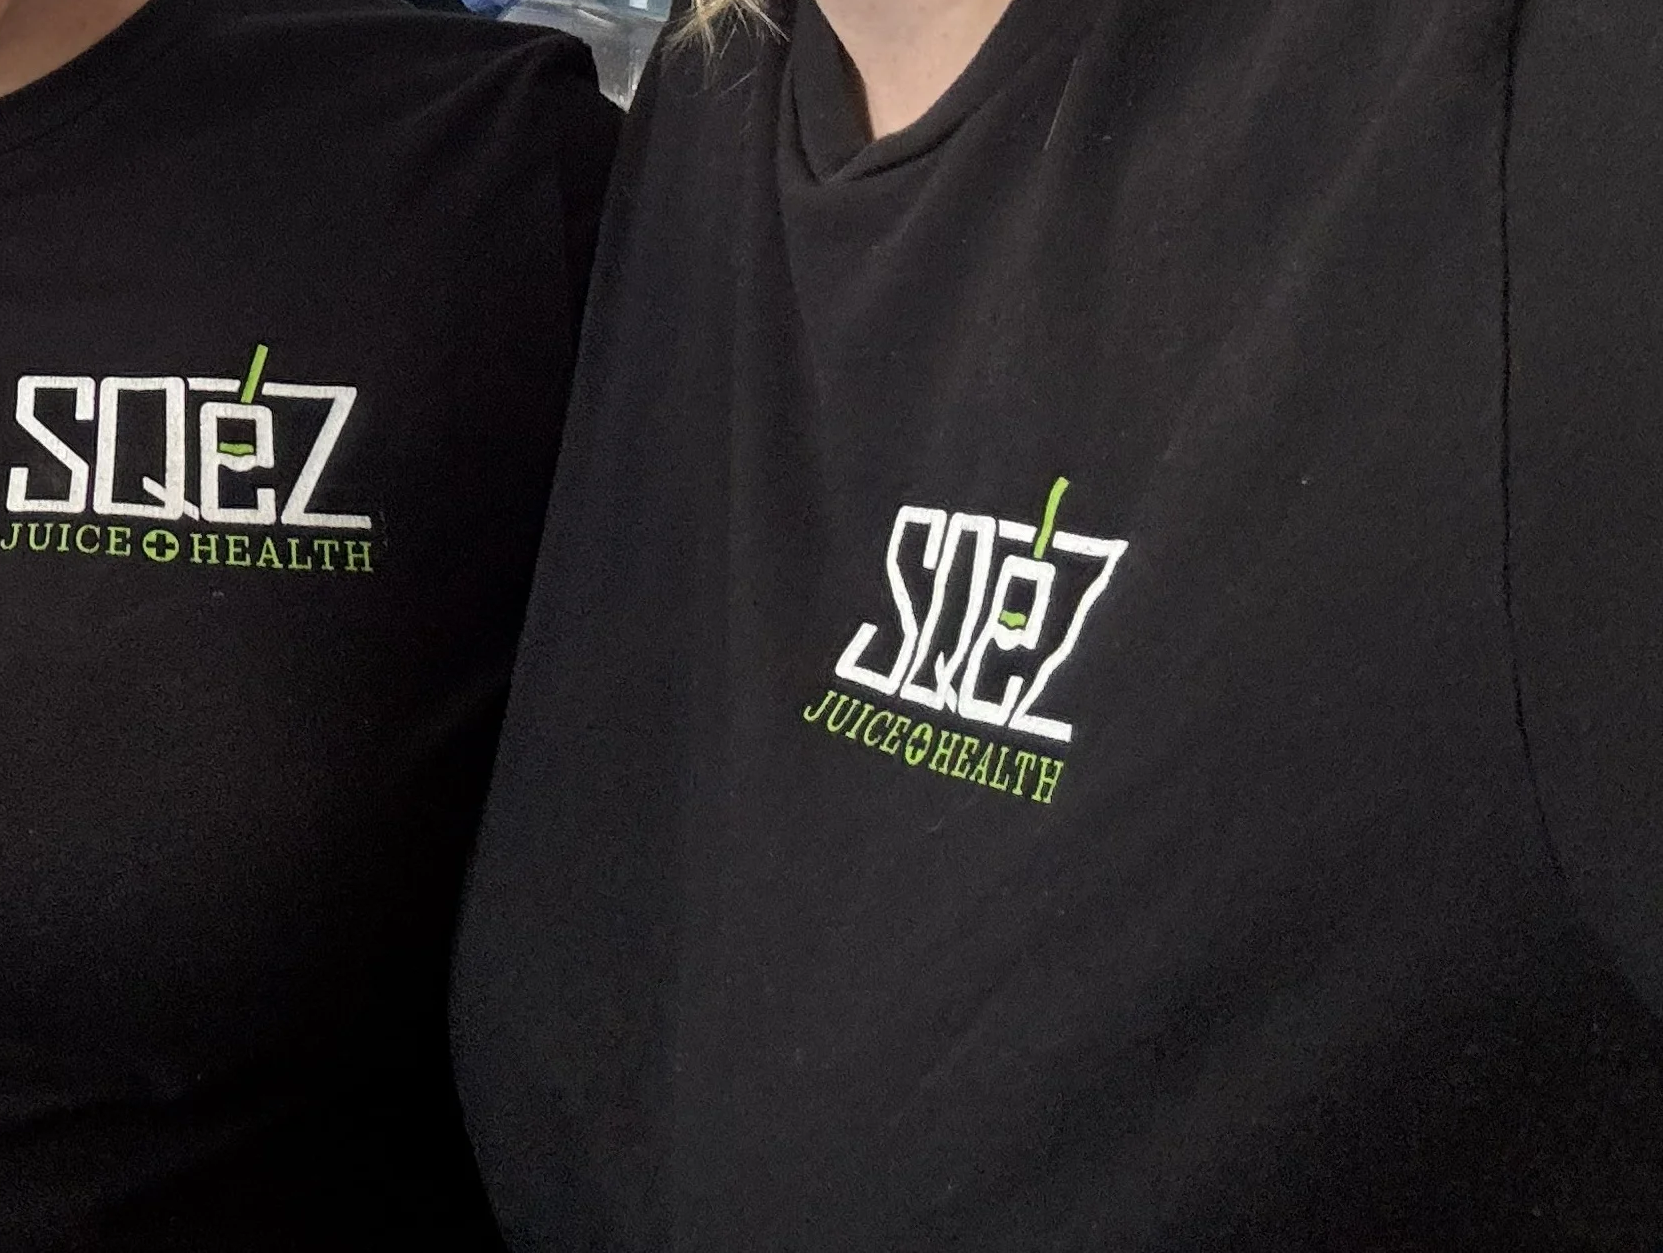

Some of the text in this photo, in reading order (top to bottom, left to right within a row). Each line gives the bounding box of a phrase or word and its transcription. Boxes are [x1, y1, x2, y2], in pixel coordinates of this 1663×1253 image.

[0, 523, 373, 572] JUICE HEALTH
[803, 690, 1065, 805] JUICE HEALTH
